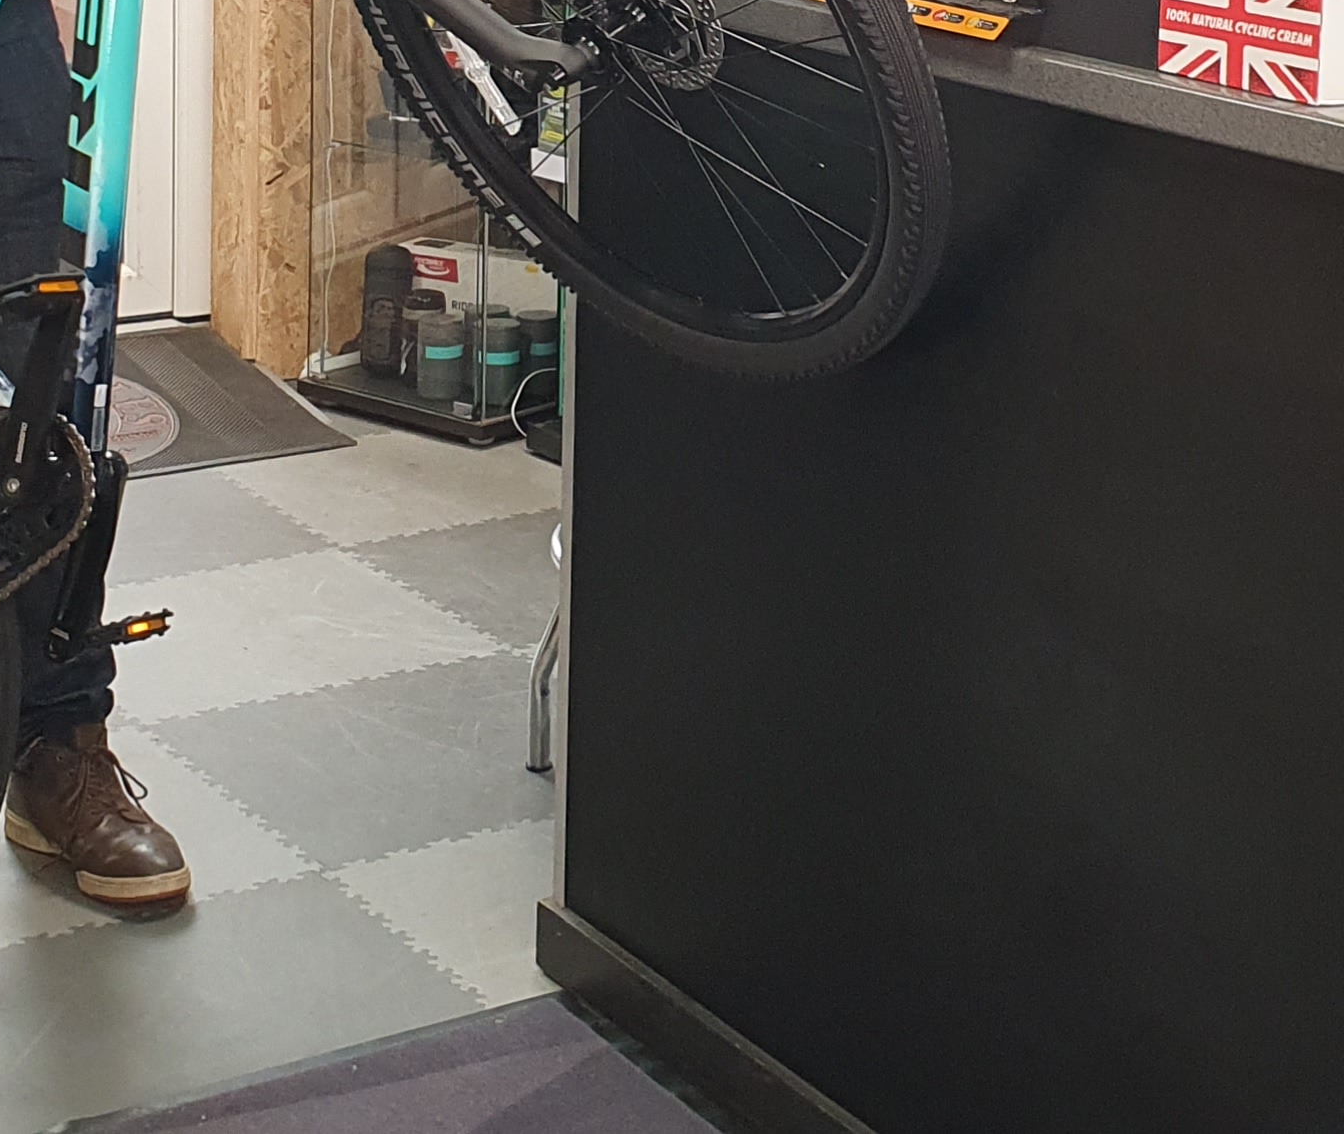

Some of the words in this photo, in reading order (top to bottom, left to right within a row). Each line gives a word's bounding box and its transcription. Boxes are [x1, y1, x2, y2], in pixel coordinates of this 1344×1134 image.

[1166, 8, 1191, 25] 100%
[1191, 12, 1234, 33] NATURAL
[1235, 20, 1275, 41] CYCLING
[1277, 27, 1313, 47] CREAM
